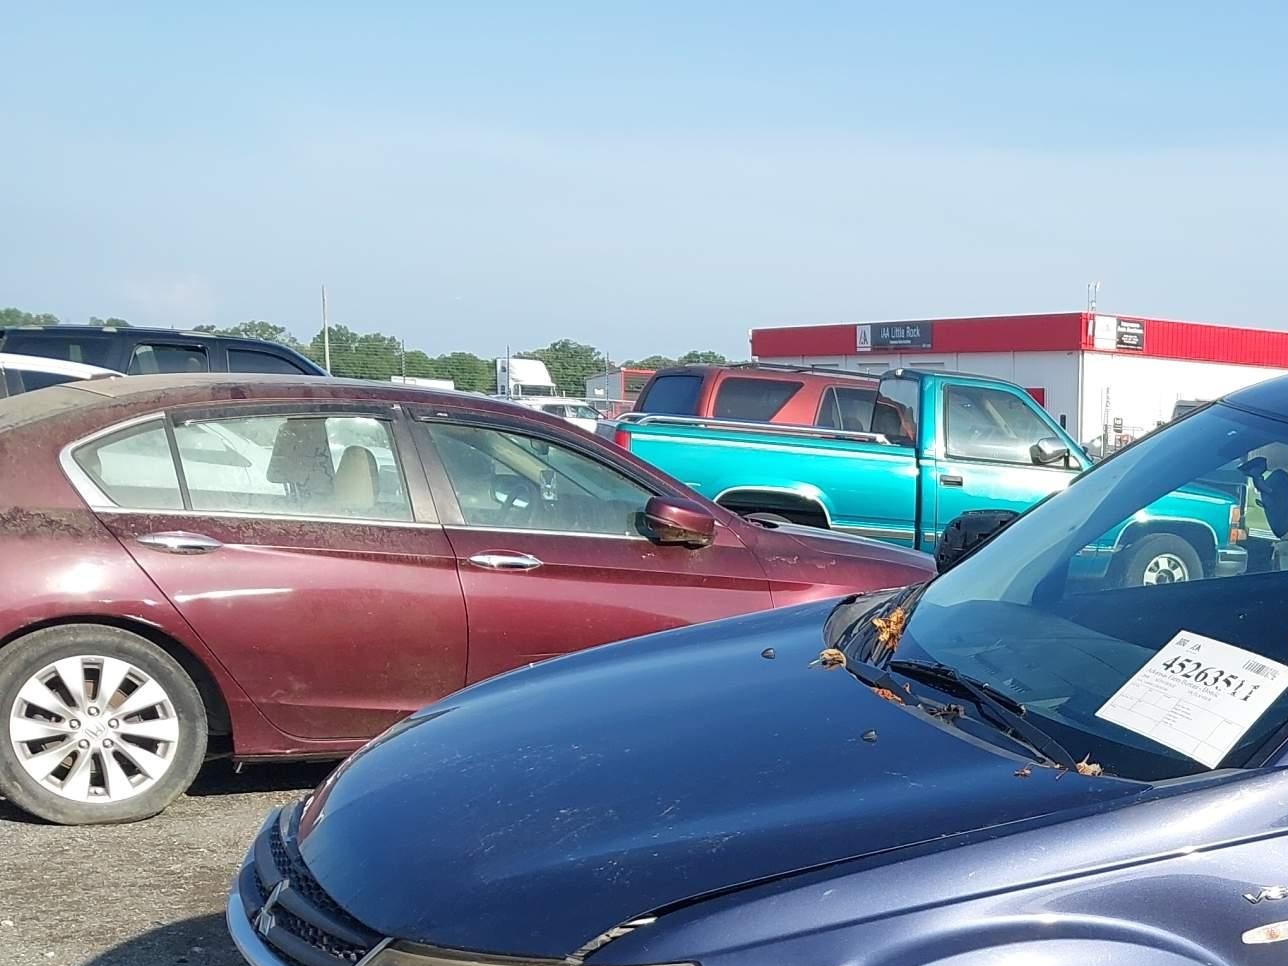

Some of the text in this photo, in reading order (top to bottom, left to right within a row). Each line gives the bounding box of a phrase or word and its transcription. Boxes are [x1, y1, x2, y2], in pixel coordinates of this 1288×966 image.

[891, 326, 905, 338] Little
[906, 325, 921, 338] Rock
[1161, 655, 1260, 702] 45263511
